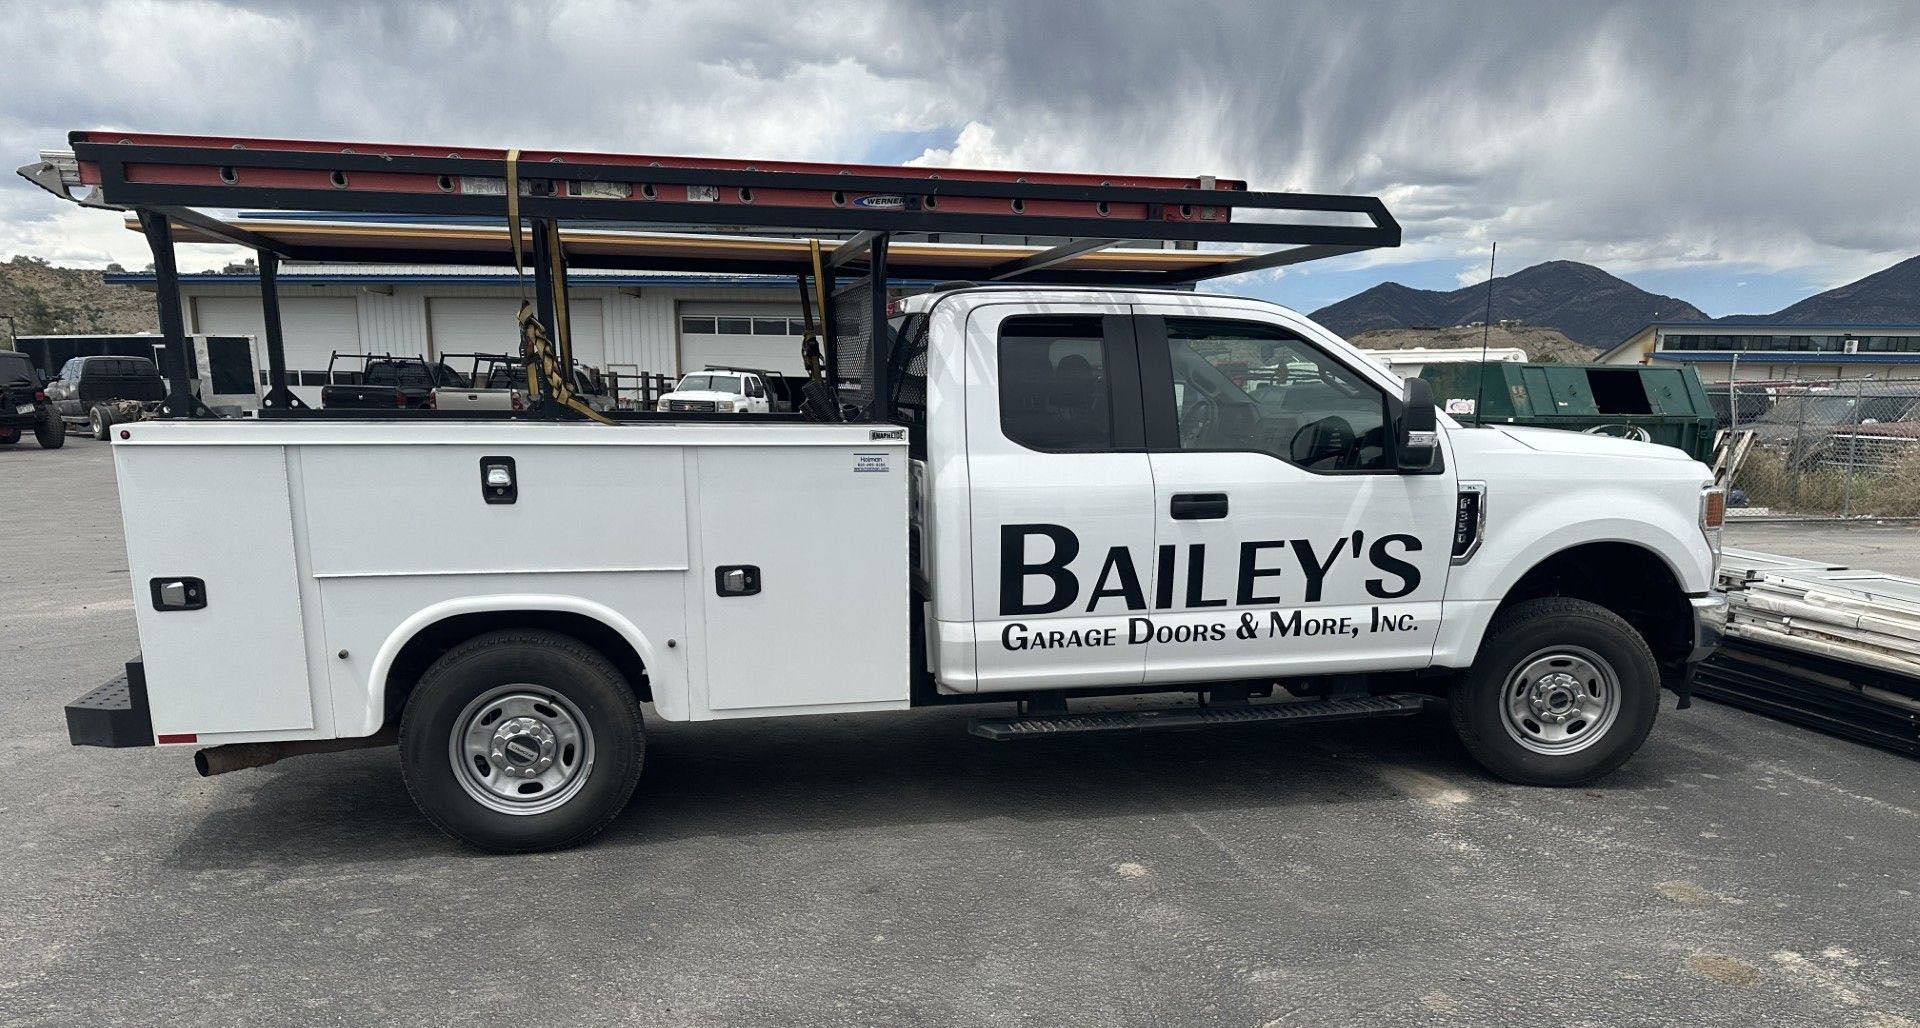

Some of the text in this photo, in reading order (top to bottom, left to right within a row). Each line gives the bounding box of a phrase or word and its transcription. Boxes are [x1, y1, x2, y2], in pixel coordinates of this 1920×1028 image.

[867, 196, 905, 206] WERNER
[999, 523, 1423, 616] BAILEY'S
[1001, 606, 1418, 651] GARAGE DOORS & MORE, INC.
